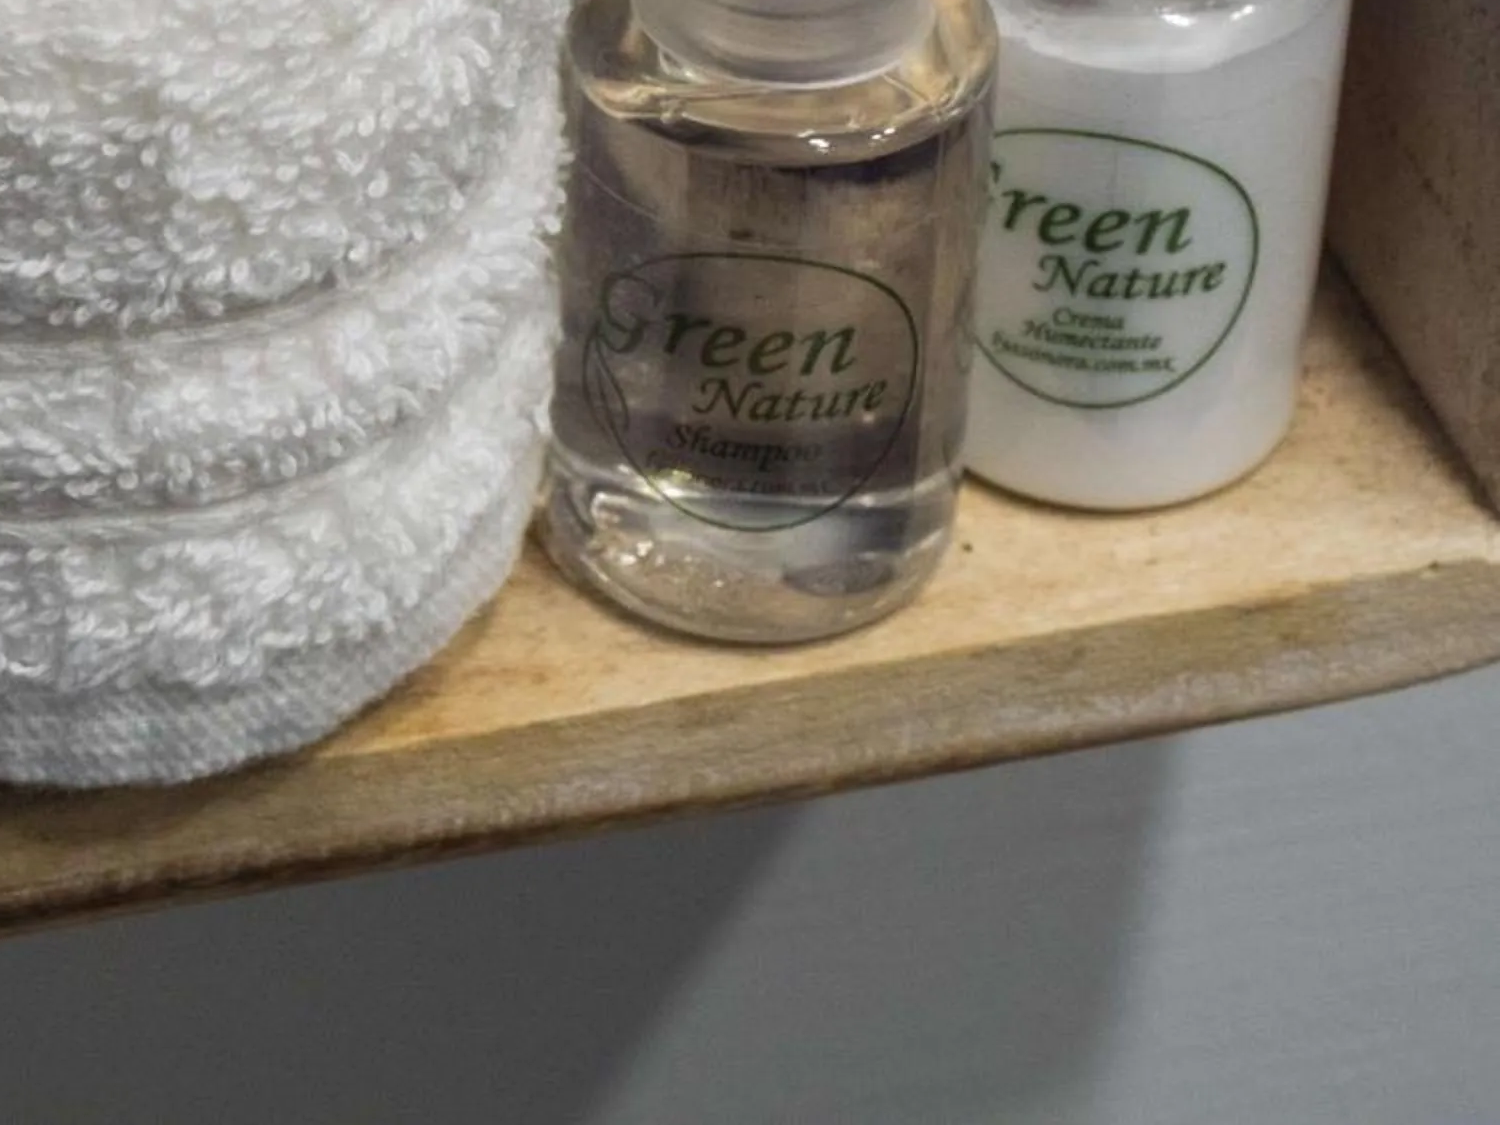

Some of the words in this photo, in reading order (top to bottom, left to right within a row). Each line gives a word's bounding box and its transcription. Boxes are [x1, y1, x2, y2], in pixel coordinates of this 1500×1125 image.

[989, 161, 1193, 256] reen
[1032, 254, 1228, 300] Nature
[600, 273, 858, 376] Green
[1052, 306, 1126, 331] Crema
[691, 377, 888, 423] Nature
[665, 423, 823, 472] Shampoo
